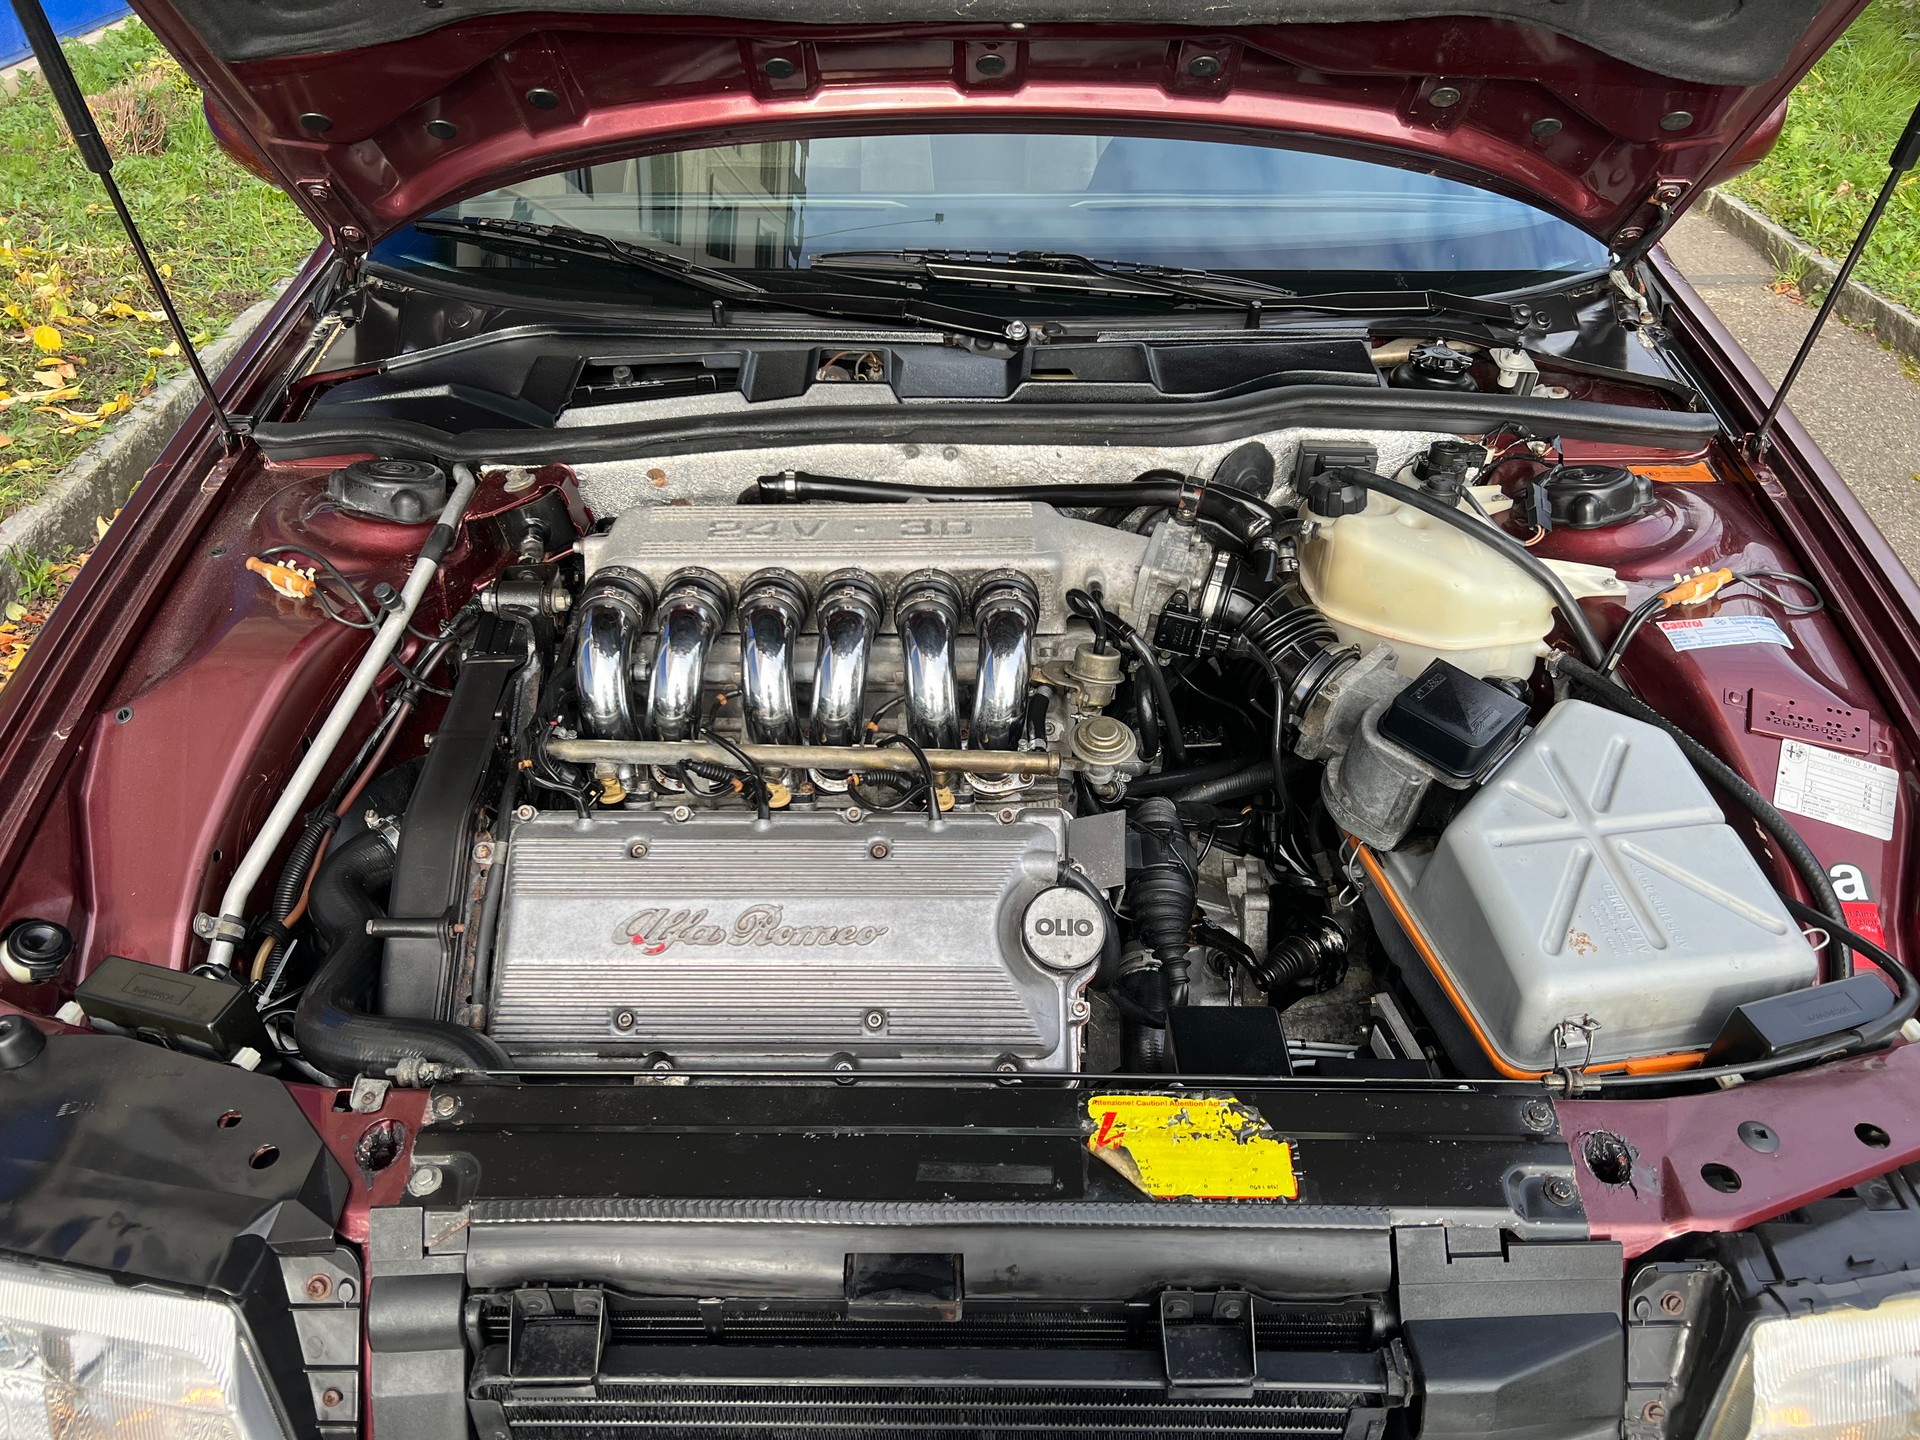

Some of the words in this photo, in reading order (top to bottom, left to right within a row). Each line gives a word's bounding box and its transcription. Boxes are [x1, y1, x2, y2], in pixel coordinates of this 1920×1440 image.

[1661, 620, 1703, 630] Castrol
[1843, 757, 1861, 768] AUTO
[612, 908, 727, 955] Alfa
[727, 903, 890, 946] Romeo
[1035, 918, 1094, 937] OLIO
[1092, 1099, 1134, 1107] Attenzione!
[1136, 1099, 1168, 1107] Caution!
